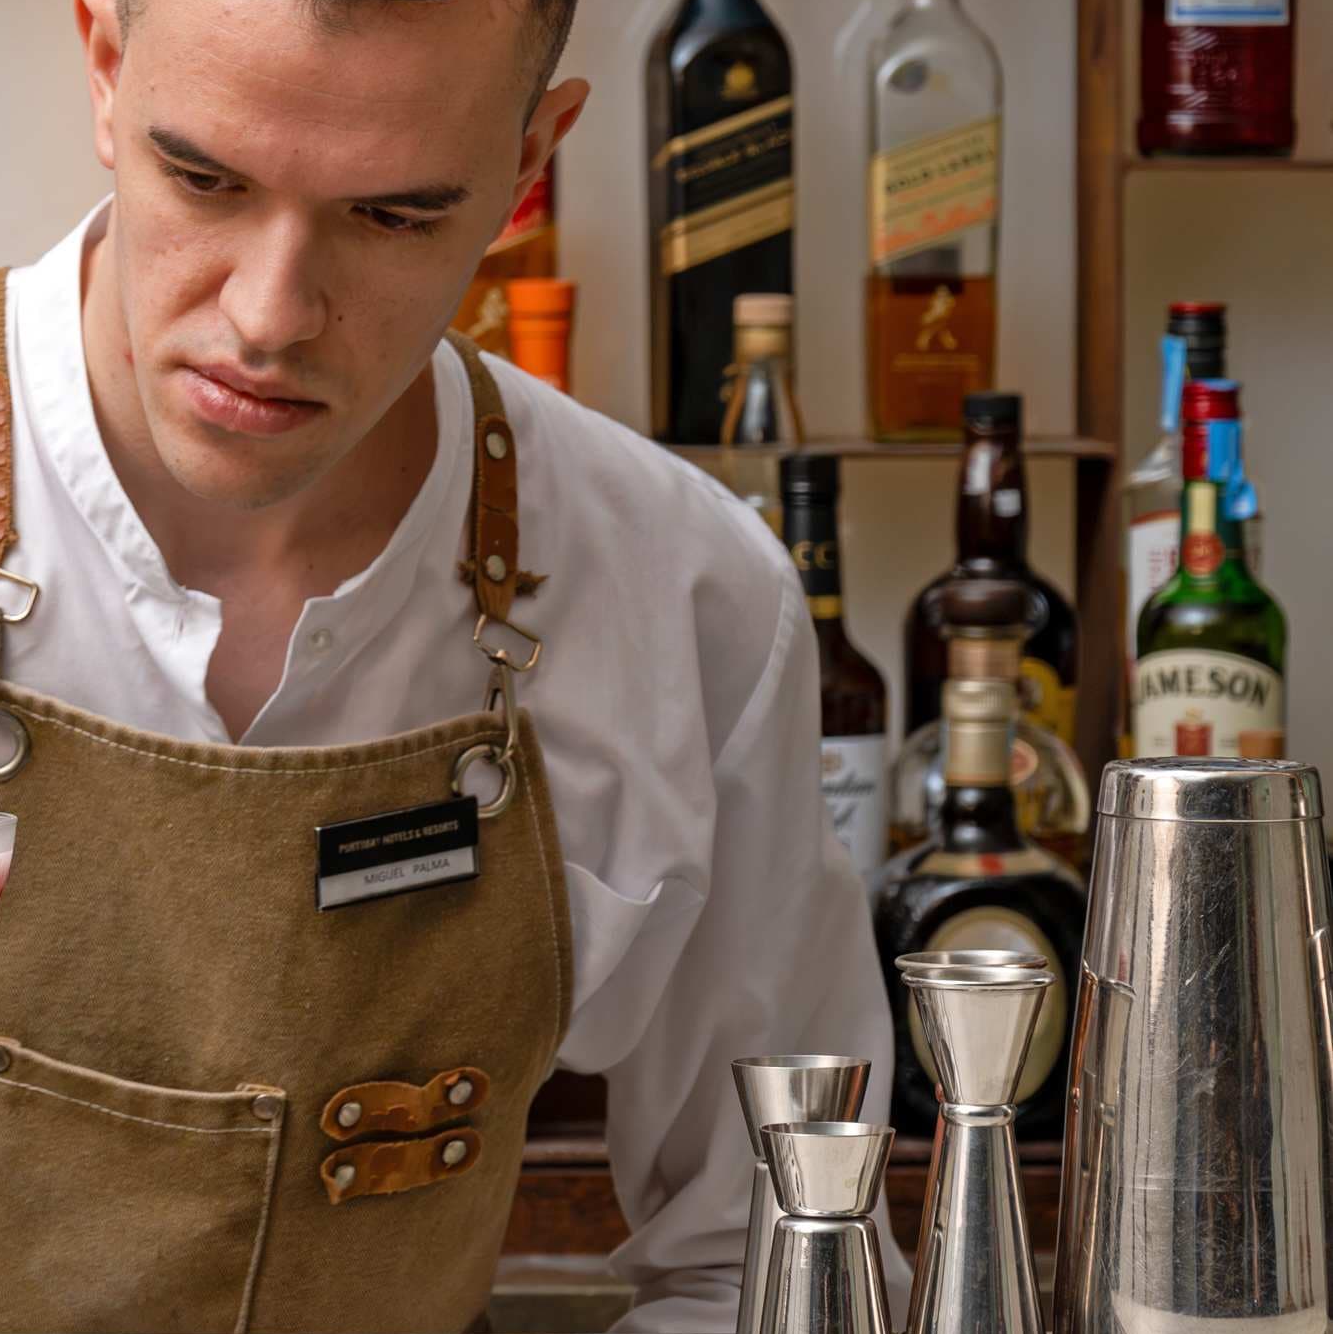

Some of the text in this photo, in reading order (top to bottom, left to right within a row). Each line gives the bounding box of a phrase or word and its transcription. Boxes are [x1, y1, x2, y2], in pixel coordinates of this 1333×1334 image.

[1139, 666, 1268, 708] JAMESON
[382, 830, 413, 845] HOTELS
[422, 820, 459, 836] RESORTS
[364, 858, 450, 884] MIGUEL PALMA
